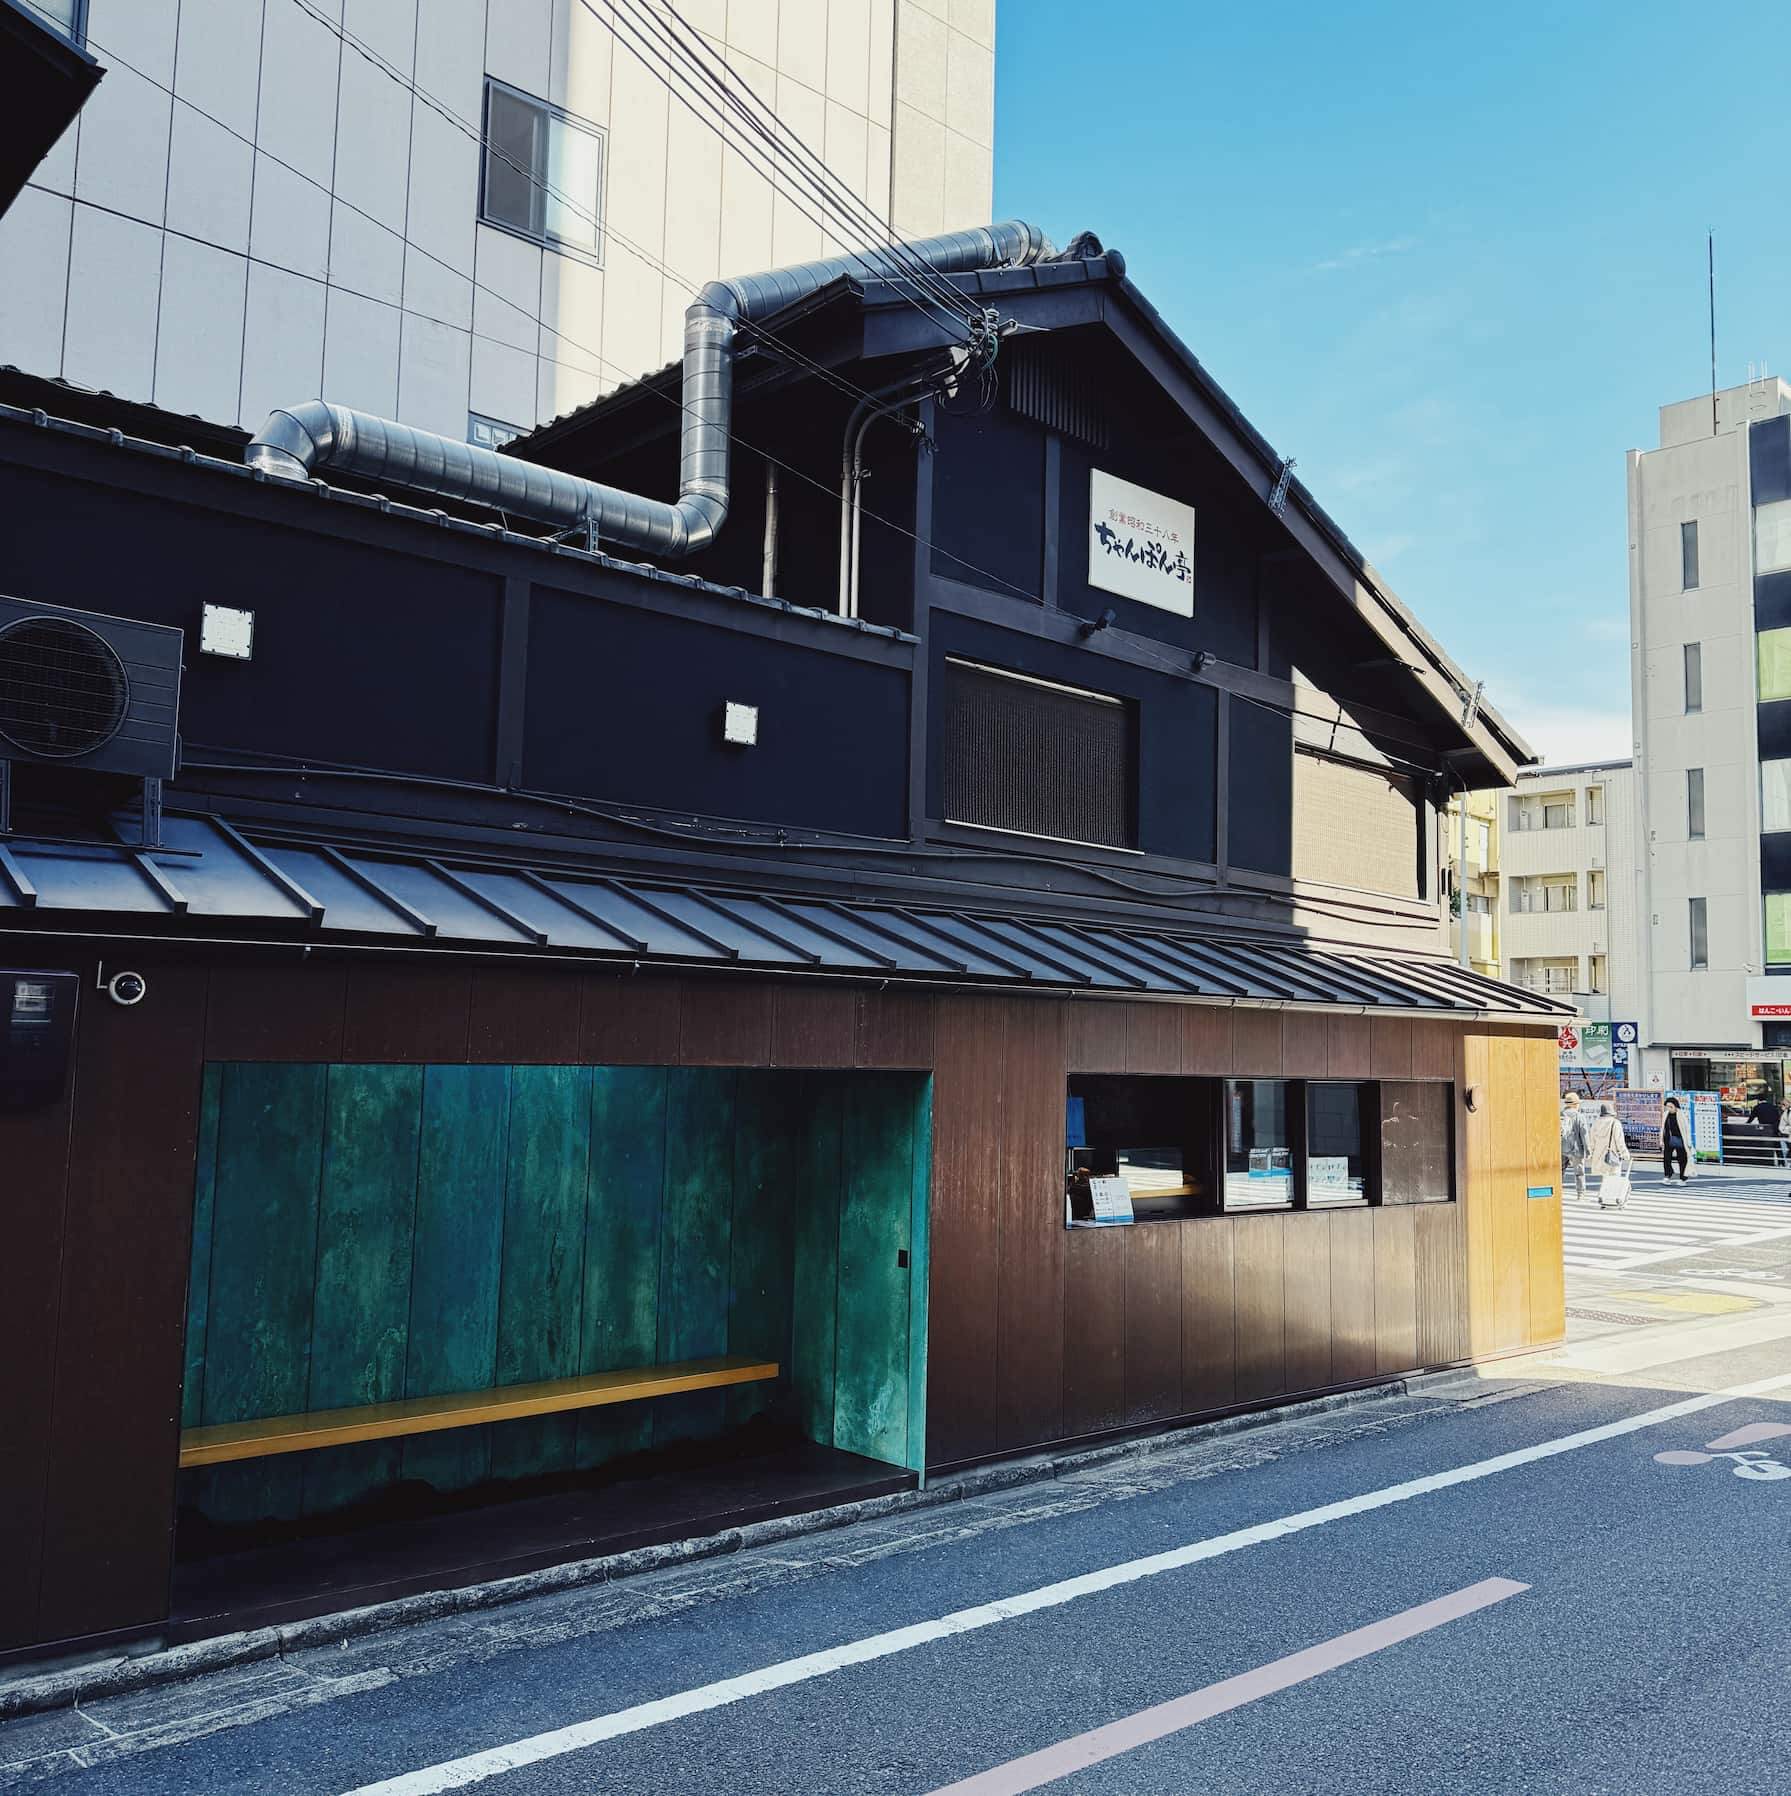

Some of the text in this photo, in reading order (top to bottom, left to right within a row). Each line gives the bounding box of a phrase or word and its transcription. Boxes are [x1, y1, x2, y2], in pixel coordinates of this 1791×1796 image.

[1108, 509, 1179, 543] 創業昭和三十八年
[1094, 521, 1191, 582] ちゃんぽん亭
